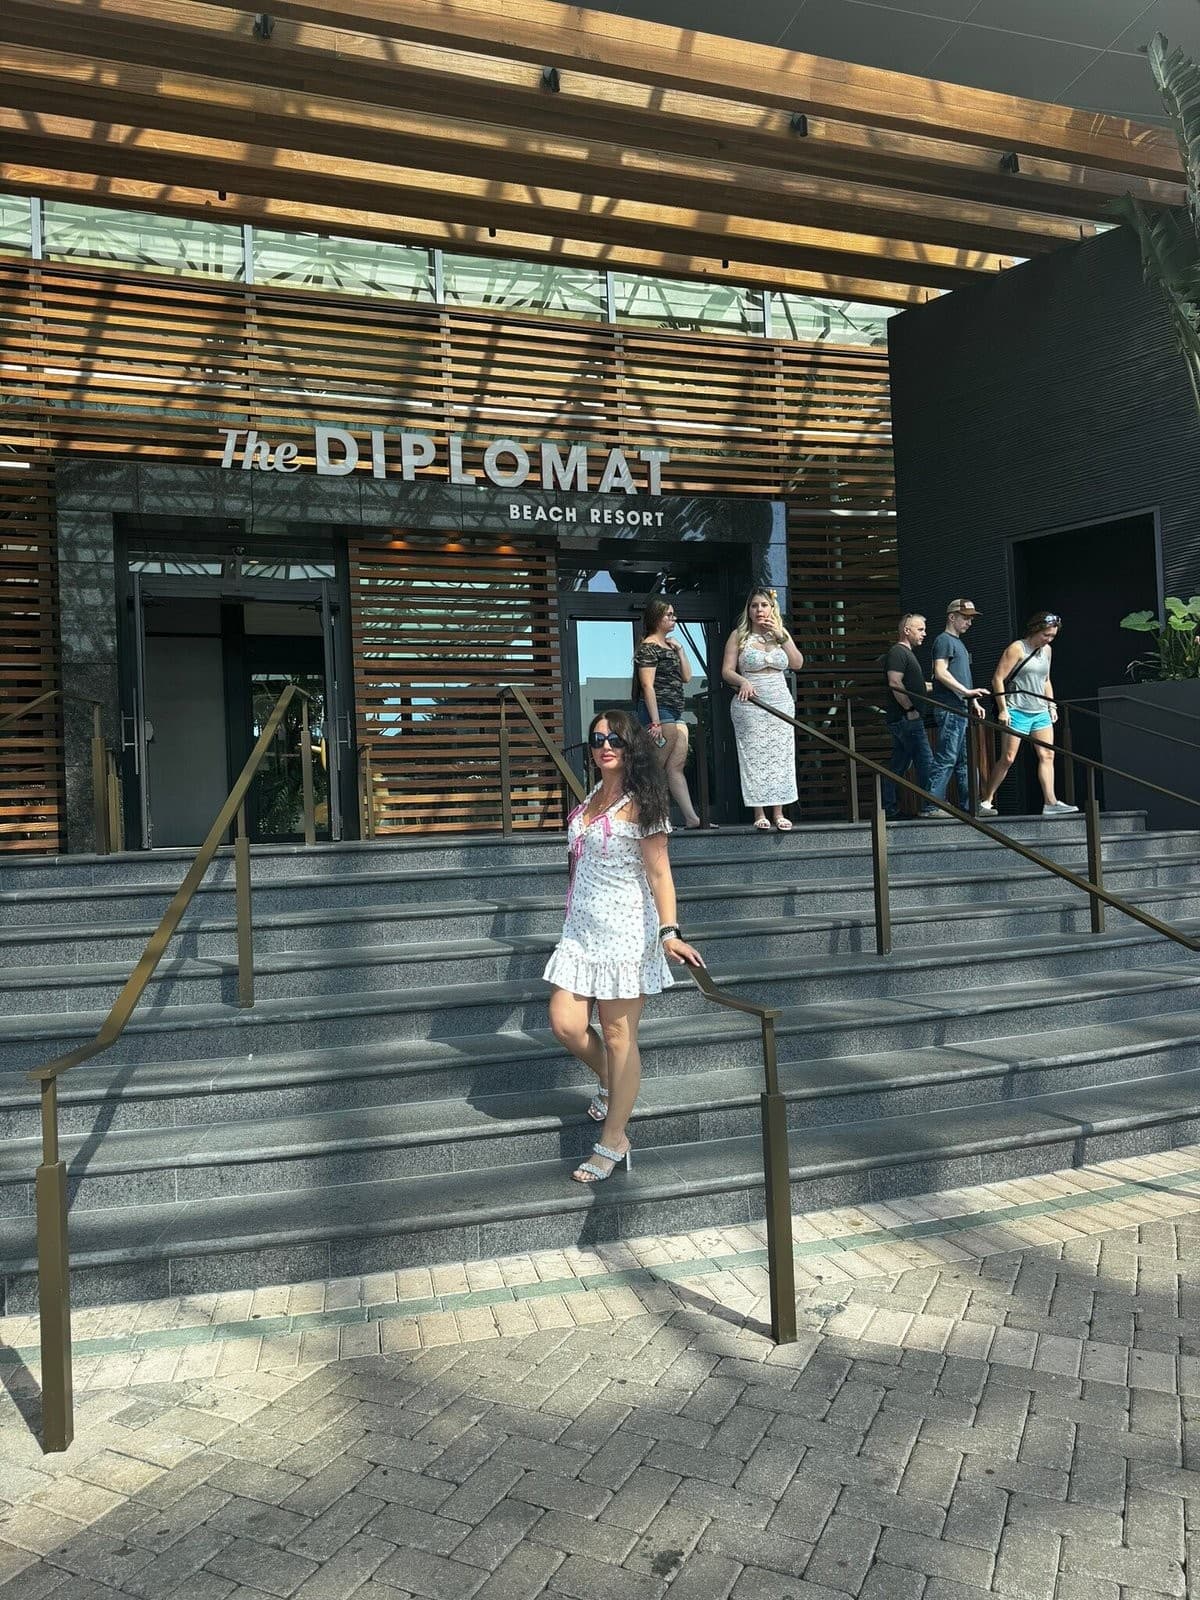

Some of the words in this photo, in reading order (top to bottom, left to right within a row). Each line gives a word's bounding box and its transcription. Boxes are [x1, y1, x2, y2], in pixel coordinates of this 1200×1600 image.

[218, 428, 302, 473] The
[314, 426, 671, 495] DIPLOMAT
[509, 504, 577, 523] BEACH
[590, 508, 665, 527] RESORT
